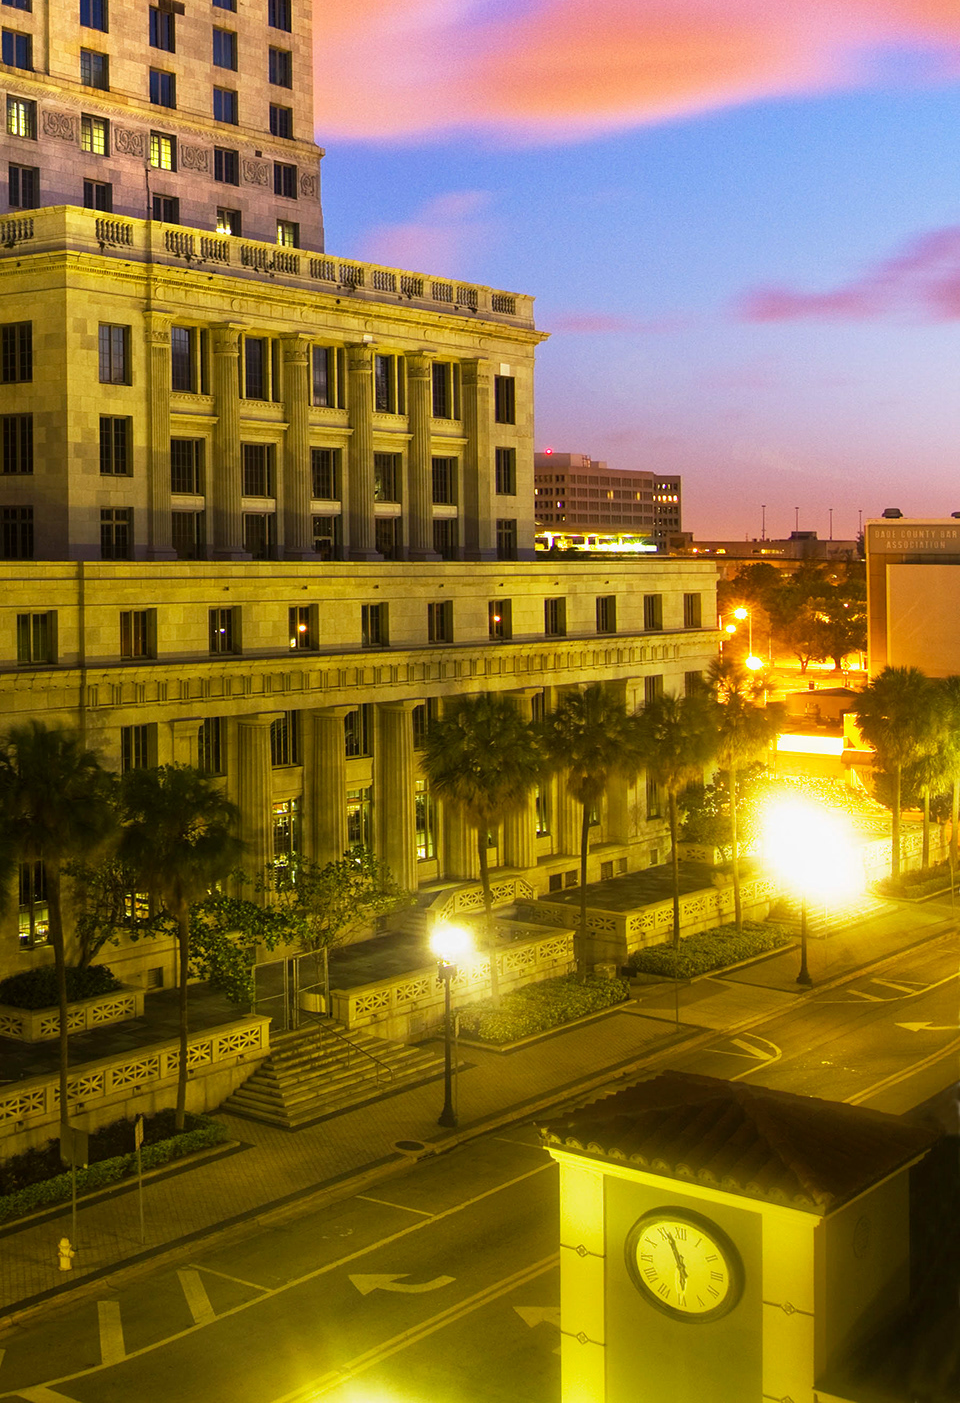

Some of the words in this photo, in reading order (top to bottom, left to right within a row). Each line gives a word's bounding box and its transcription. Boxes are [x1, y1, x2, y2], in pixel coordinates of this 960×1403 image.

[875, 530, 896, 539] DADE
[900, 530, 936, 539] COUNTY
[940, 530, 958, 539] BAR
[886, 540, 946, 549] ASSOCIATION
[674, 1226, 687, 1241] XII
[644, 1236, 658, 1249] X
[705, 1254, 719, 1263] II
[710, 1270, 724, 1282] III
